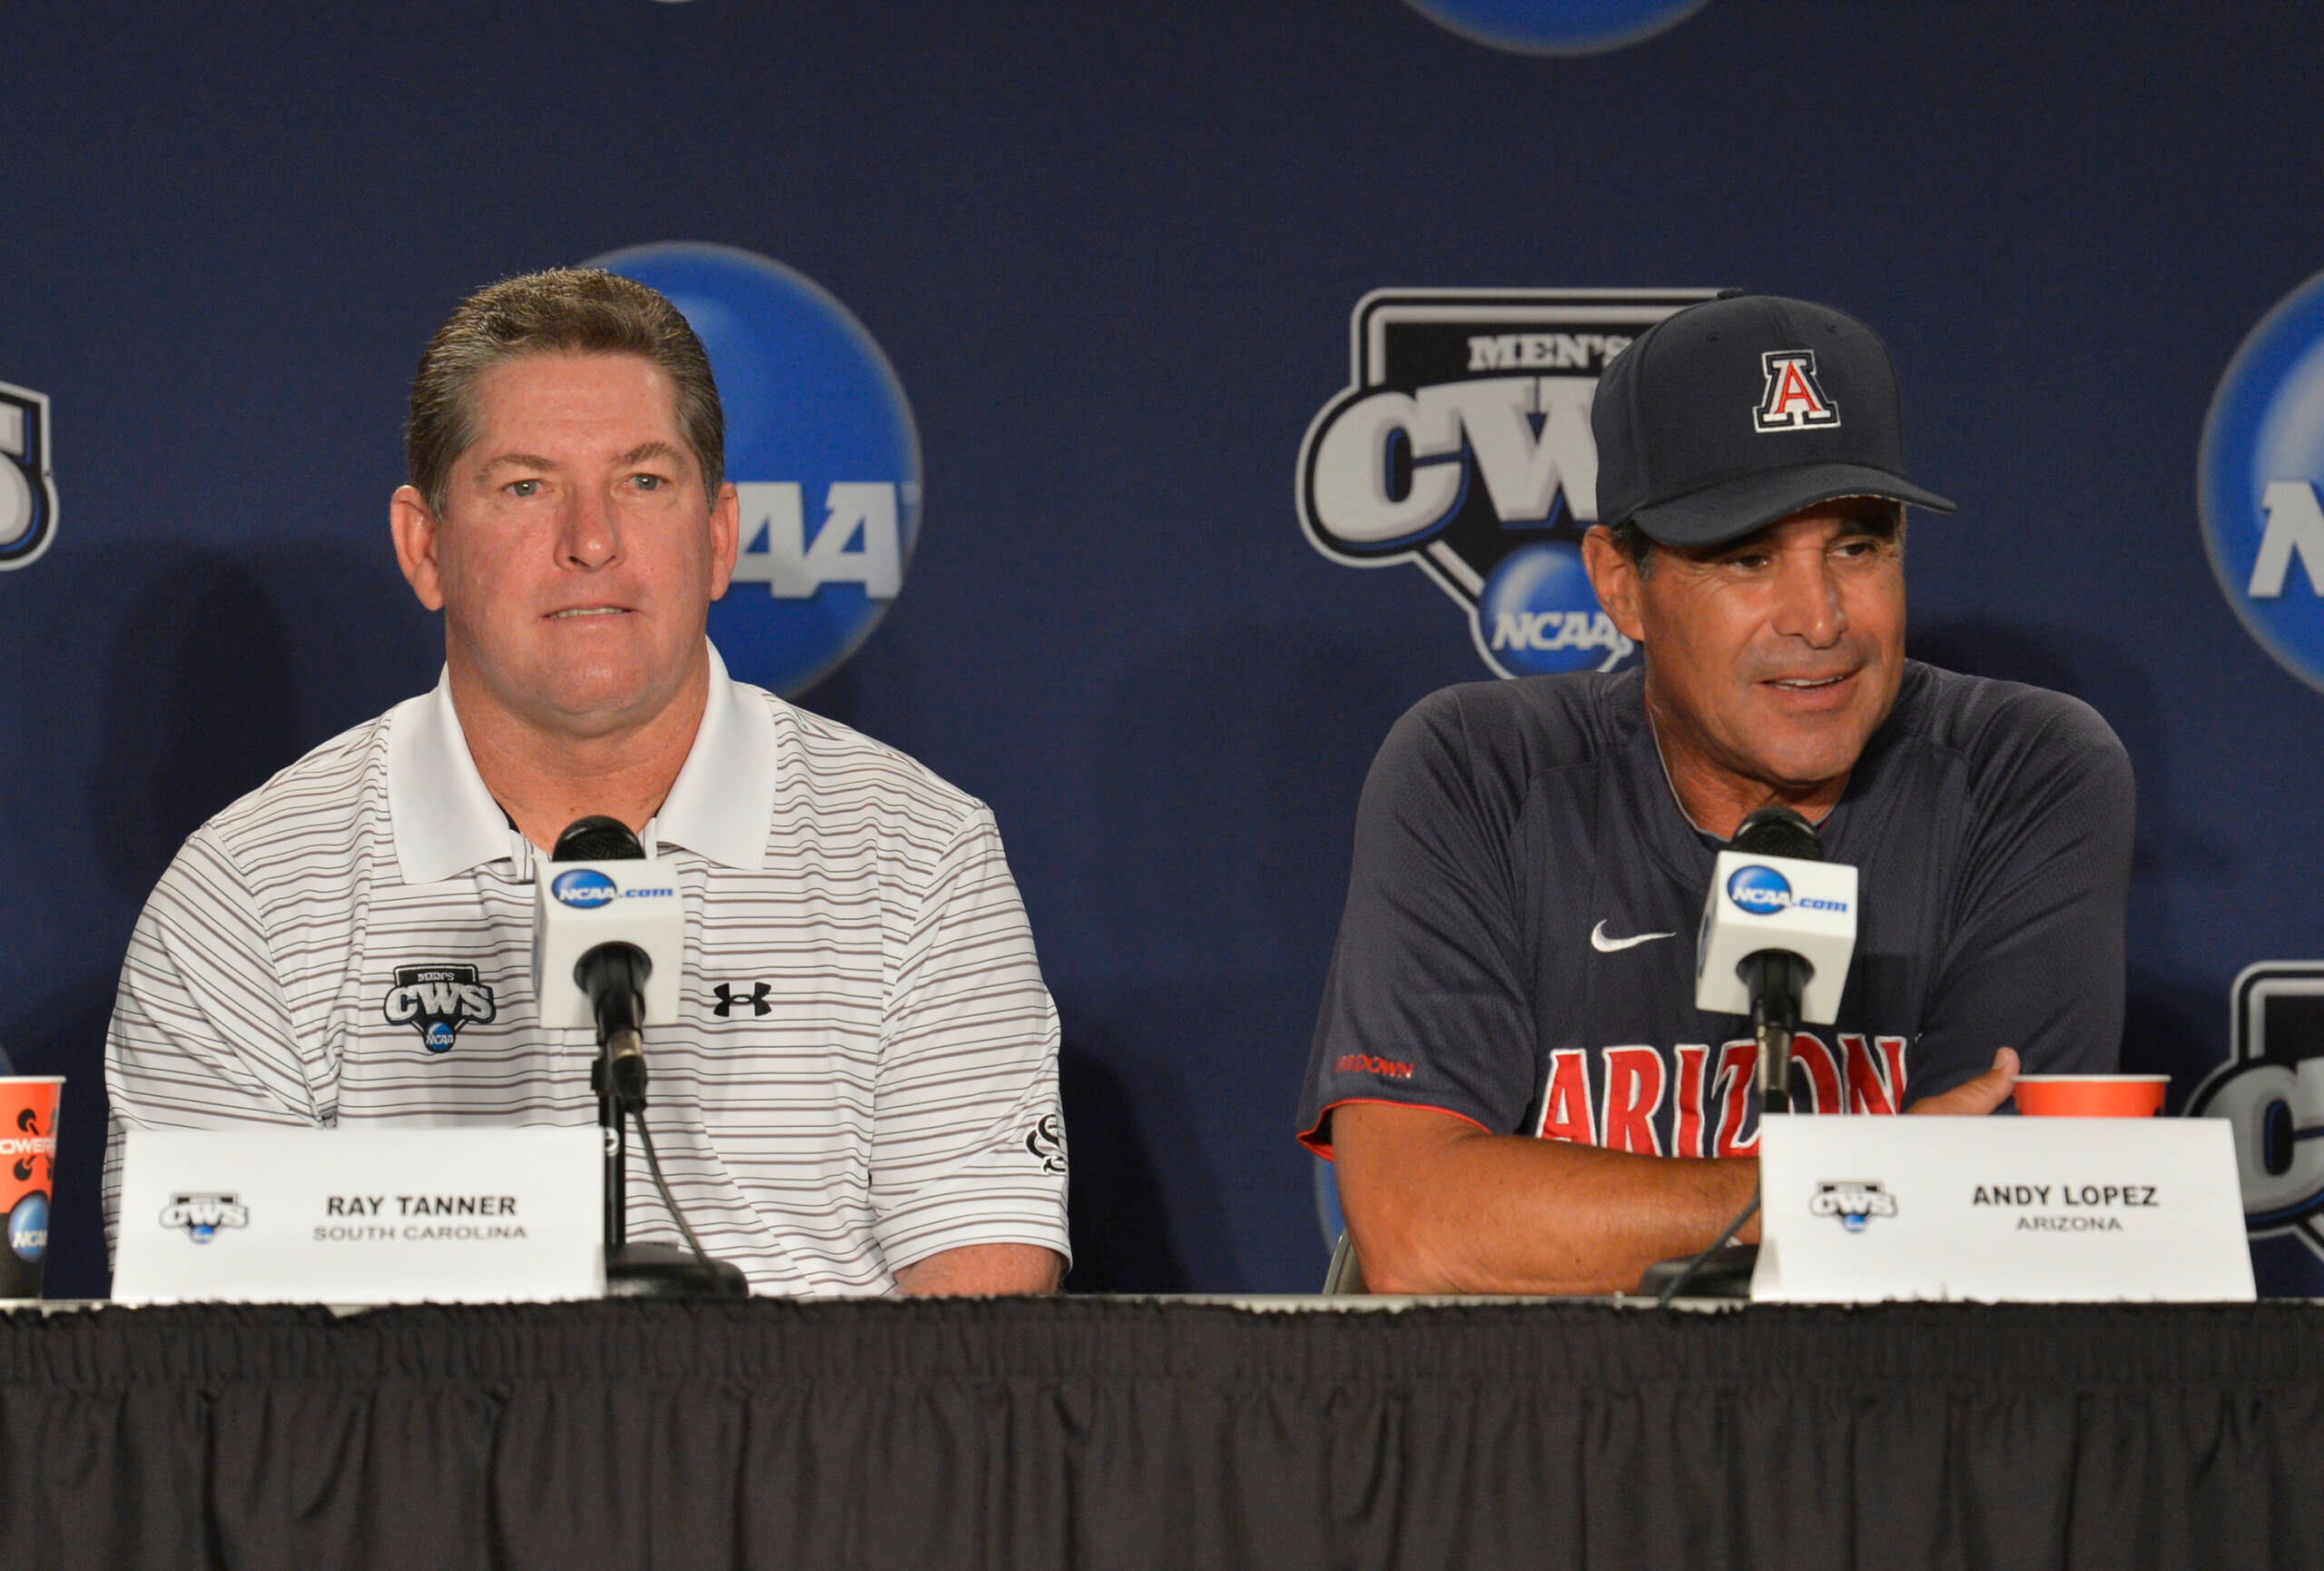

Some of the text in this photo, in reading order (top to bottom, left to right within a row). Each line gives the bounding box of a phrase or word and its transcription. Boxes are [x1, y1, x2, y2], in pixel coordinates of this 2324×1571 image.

[1753, 350, 1841, 433] A
[1492, 611, 1619, 651] NCAA
[417, 972, 455, 983] MEN'S
[385, 982, 492, 1022] CWS
[425, 1034, 454, 1045] NCAA
[327, 1195, 517, 1217] RAY TANNER
[1973, 1185, 2161, 1207] ANDY LOPEZ
[313, 1225, 528, 1241] SOUTH CAROLINA
[2017, 1217, 2123, 1231] ARIZONA
